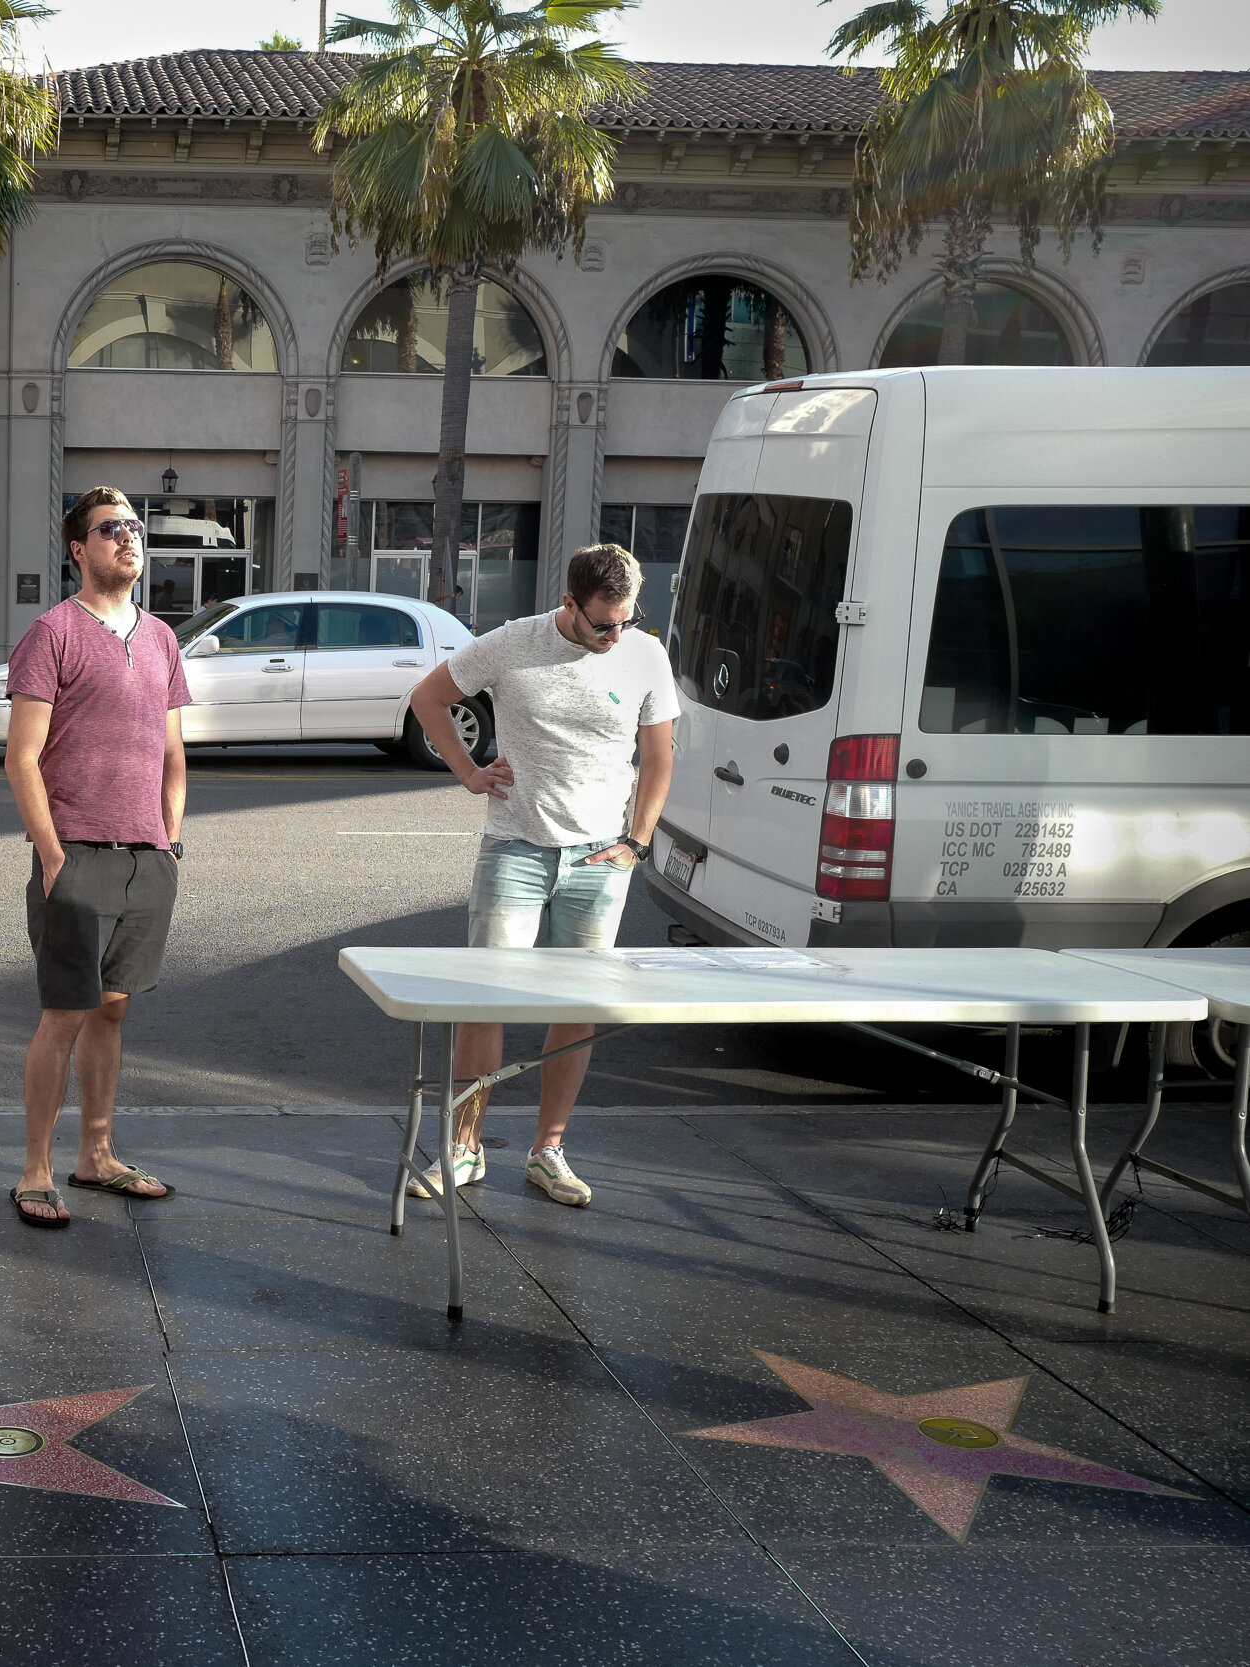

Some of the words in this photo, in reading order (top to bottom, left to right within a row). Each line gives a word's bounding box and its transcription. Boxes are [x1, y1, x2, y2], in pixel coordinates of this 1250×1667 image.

[946, 801, 979, 818] YANICE
[981, 802, 1016, 818] TRAVEL
[1017, 802, 1056, 818] AGENCY
[1058, 803, 1076, 819] INC.
[944, 821, 965, 838] US
[969, 822, 1002, 838] DOT
[1014, 822, 1074, 839] 2291452
[941, 841, 968, 857] ICC
[971, 842, 996, 858] MC
[1021, 842, 1071, 858] 782489
[940, 861, 970, 877] TCP
[1002, 862, 1053, 878] 028793
[1055, 862, 1067, 878] A
[936, 880, 958, 896] CA
[1013, 881, 1066, 897] 425632
[744, 911, 757, 928] TCP
